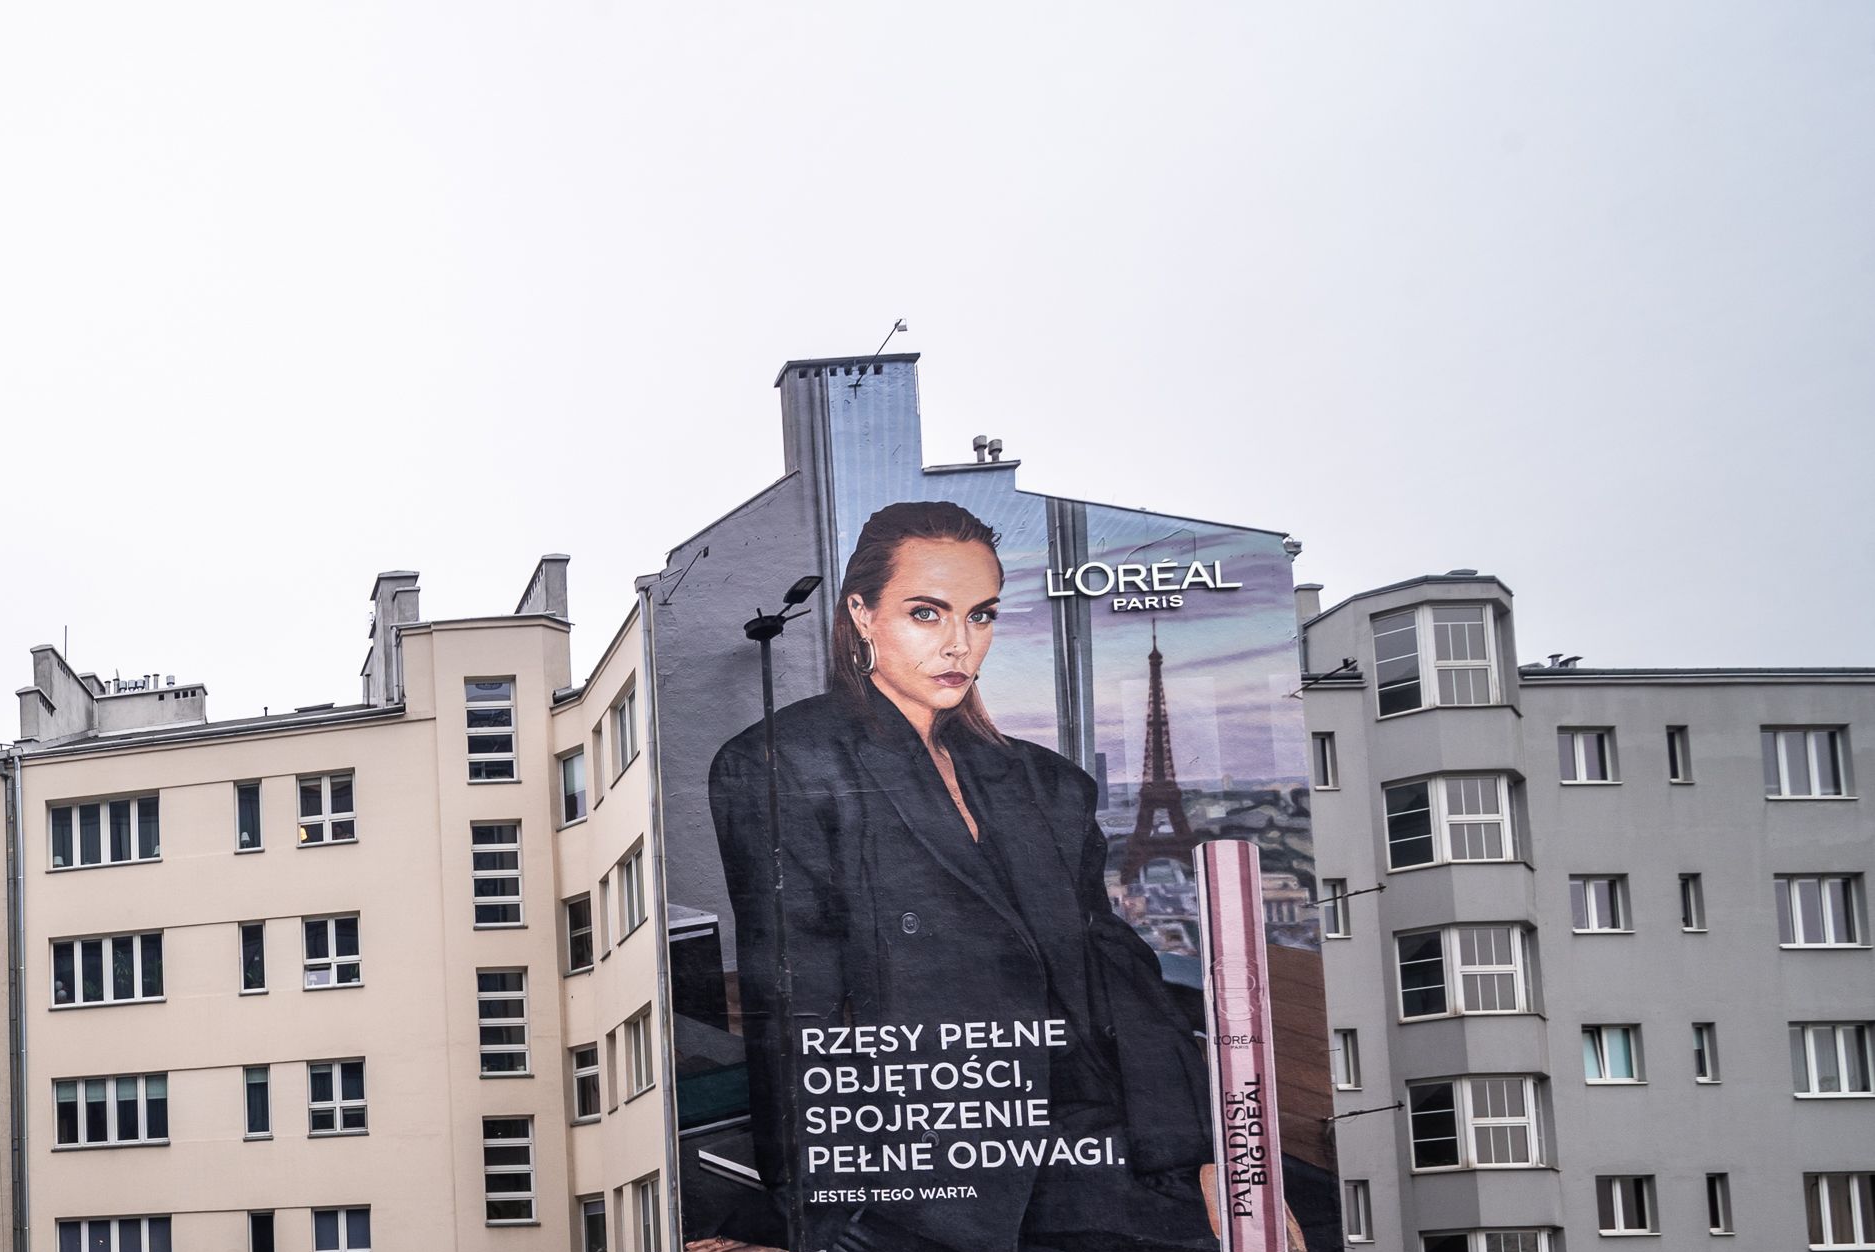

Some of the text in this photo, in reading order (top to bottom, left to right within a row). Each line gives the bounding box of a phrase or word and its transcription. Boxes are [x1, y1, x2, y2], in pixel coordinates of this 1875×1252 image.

[1044, 558, 1243, 598] L'ORÉAL
[801, 1019, 1067, 1058] RZĘSY PEŁNE
[803, 1054, 1033, 1097] OBJĘTOŚCI,
[805, 1098, 1051, 1134] SPOJRZENIE
[1244, 1073, 1268, 1187] BIG DEAL
[808, 1137, 1126, 1173] PEŁNE ODWAGI.
[1225, 1091, 1254, 1219] PARADISE
[809, 1185, 978, 1203] JESTEŚ TEGO WARTA
